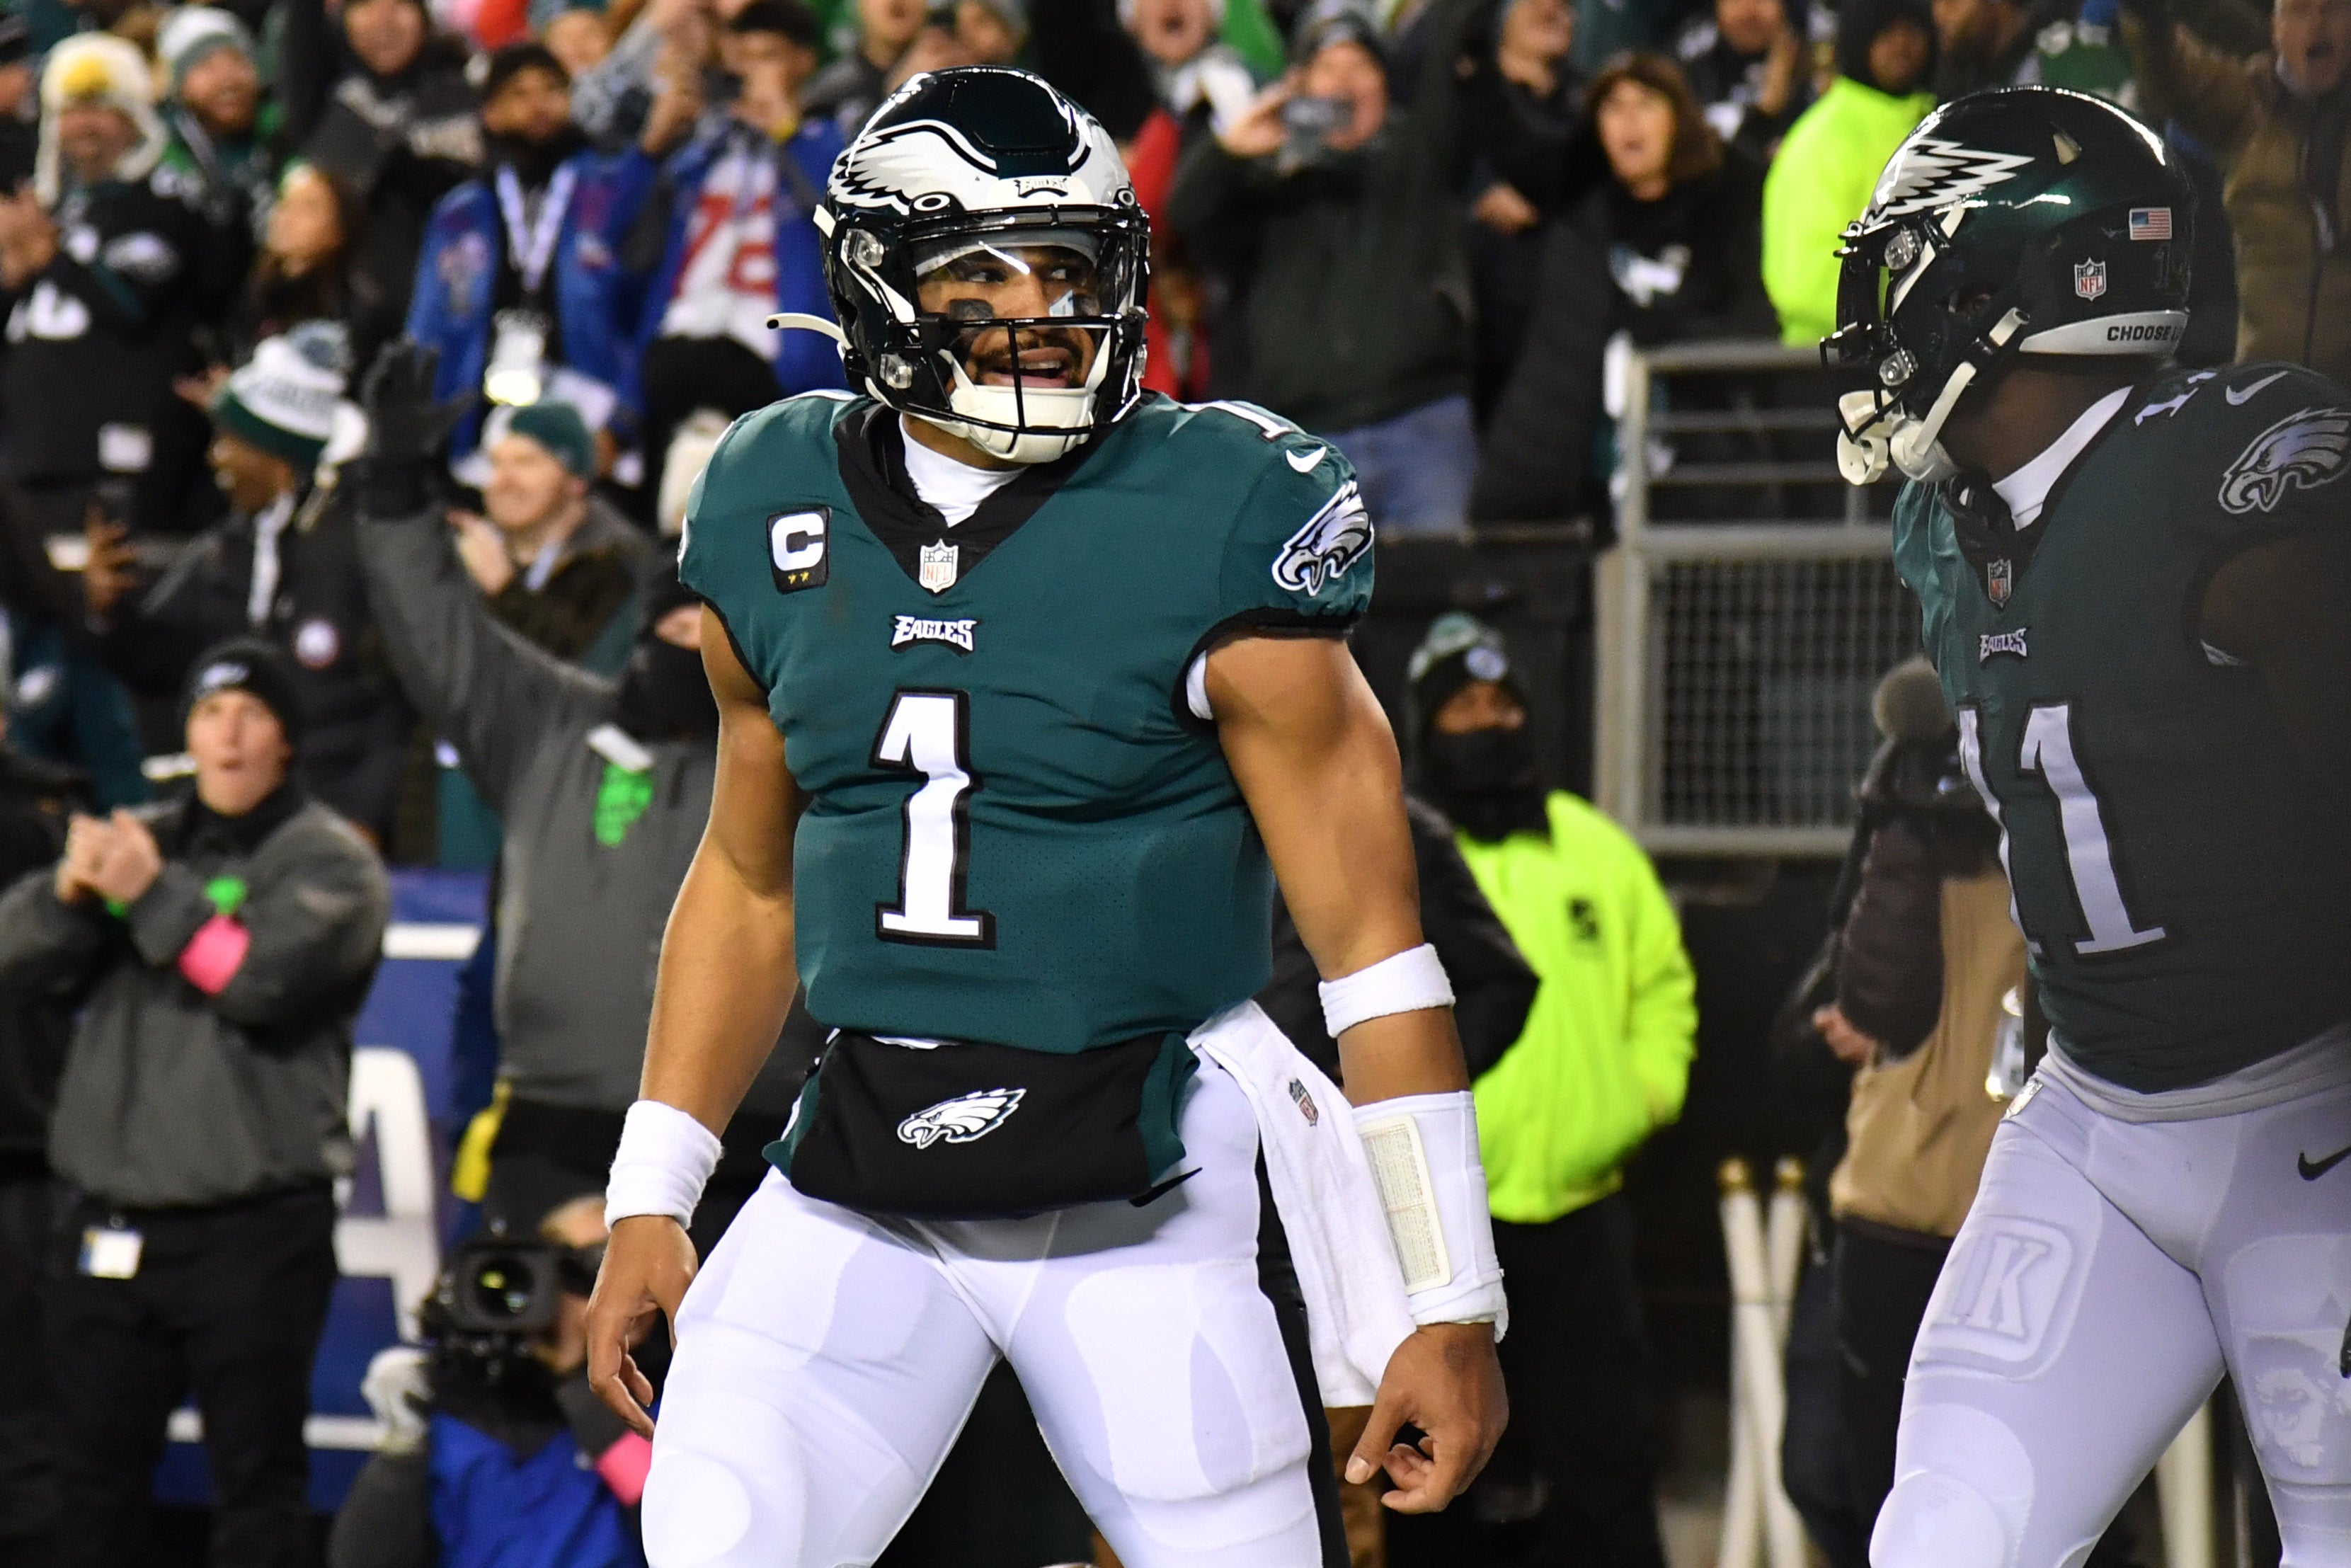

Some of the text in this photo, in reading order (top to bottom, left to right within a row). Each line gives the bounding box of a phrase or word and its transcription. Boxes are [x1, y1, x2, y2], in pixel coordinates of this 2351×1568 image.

[2079, 276, 2103, 294] NFL
[2107, 326, 2172, 342] CHOOSE
[771, 513, 824, 571] C
[925, 564, 950, 582] NFL
[891, 614, 978, 653] EAGLES
[1979, 627, 2027, 663] EAGLES
[873, 691, 989, 945] 1
